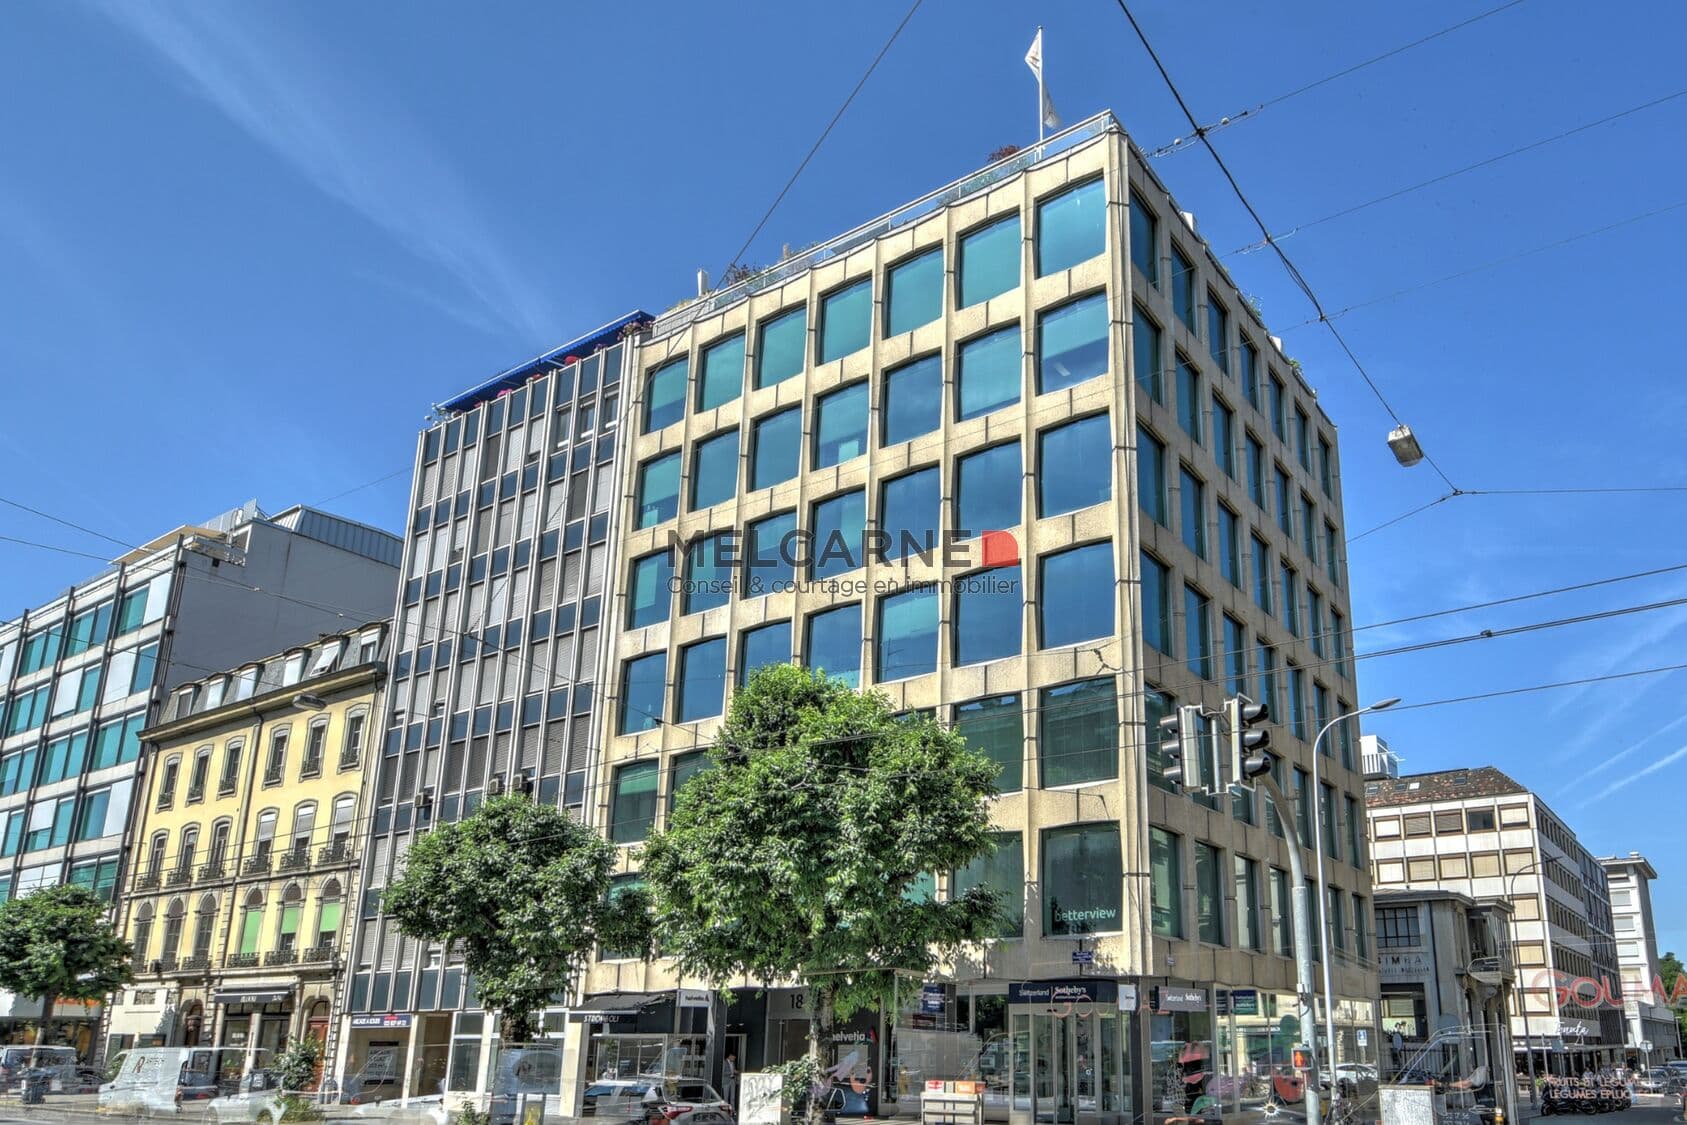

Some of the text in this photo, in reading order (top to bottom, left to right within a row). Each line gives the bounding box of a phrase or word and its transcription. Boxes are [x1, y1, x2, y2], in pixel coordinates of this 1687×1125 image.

[1055, 907, 1116, 921] betterview
[1055, 984, 1087, 996] Sotheby's
[1531, 972, 1687, 1009] GOUMA
[790, 994, 804, 1009] 18
[1549, 1089, 1632, 1099] LEGUMES EPLUC
